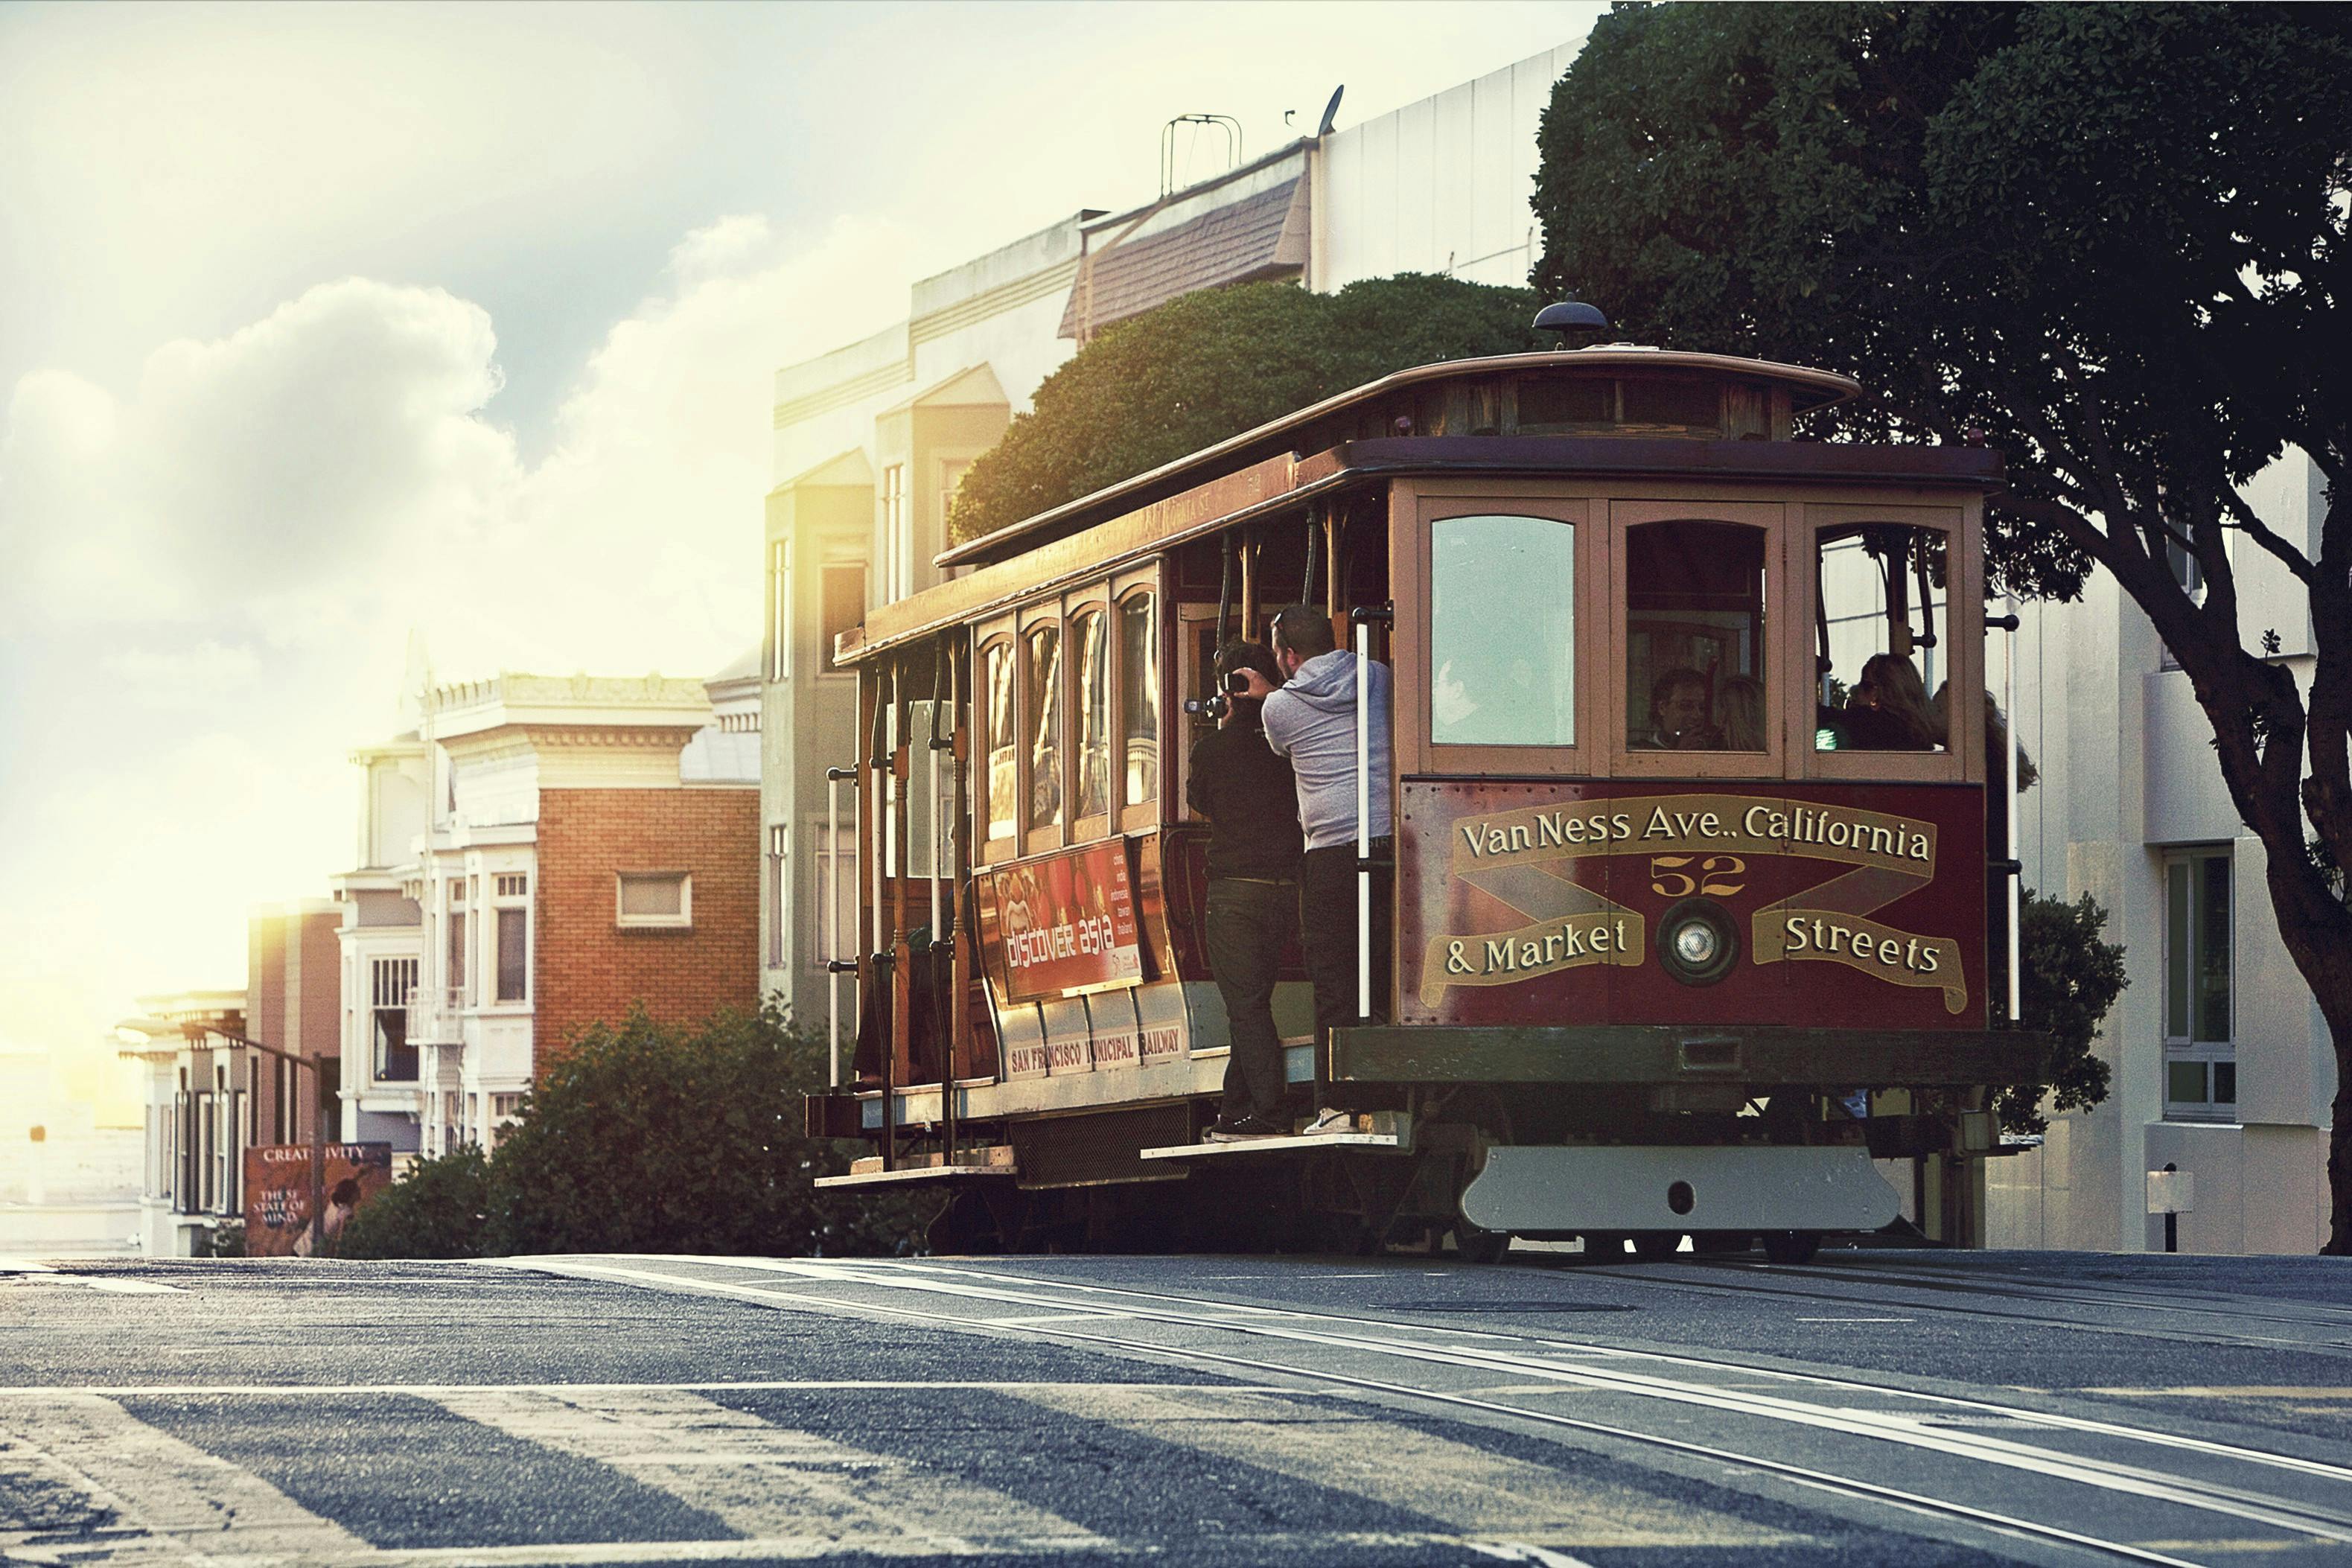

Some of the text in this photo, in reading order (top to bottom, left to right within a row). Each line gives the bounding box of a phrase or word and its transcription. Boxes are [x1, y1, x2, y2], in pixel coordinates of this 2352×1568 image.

[1461, 822, 1532, 857] Van
[1535, 812, 1631, 847] Ness
[1744, 806, 1930, 861] California
[1651, 856, 1746, 896] 52
[1447, 917, 1941, 974] & Market Streets
[1011, 1047, 1030, 1073] SAN
[1032, 1042, 1082, 1071] FRNCISCO
[1137, 1027, 1179, 1057] RAILWAY
